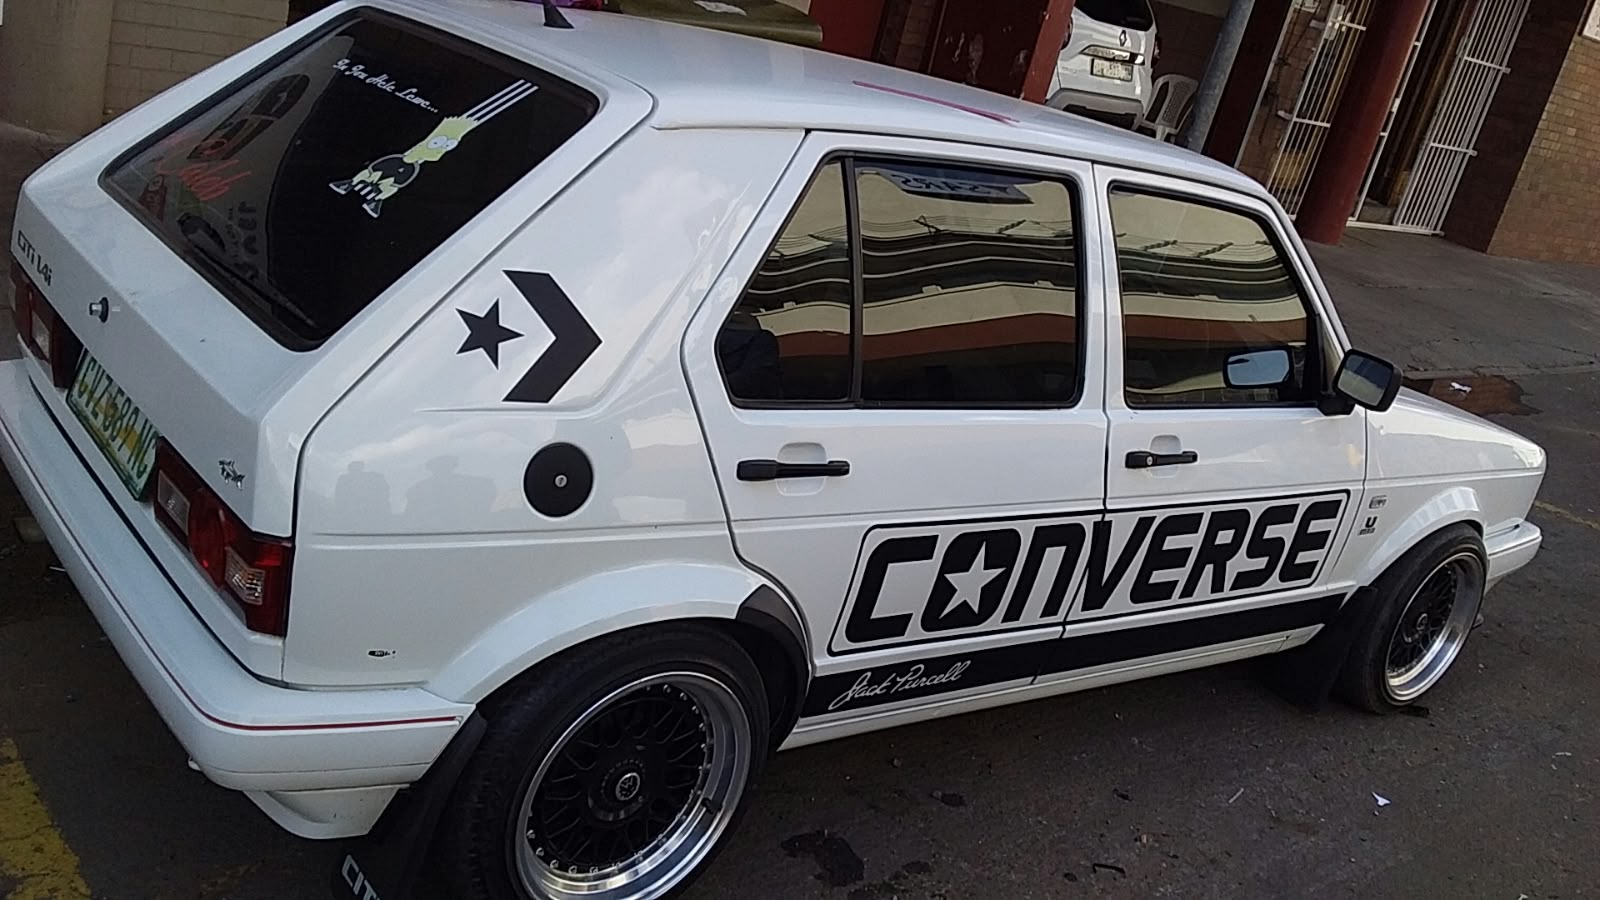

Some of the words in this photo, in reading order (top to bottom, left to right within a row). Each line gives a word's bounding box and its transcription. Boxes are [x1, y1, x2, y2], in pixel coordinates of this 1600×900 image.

[365, 73, 396, 92] Hele
[78, 355, 114, 421] CVZ
[102, 386, 140, 452] 589
[126, 418, 160, 480] NC
[844, 499, 1344, 643] CONVERSE
[828, 671, 896, 710] Jack
[890, 659, 972, 695] Purcell
[342, 854, 381, 900] CIT
